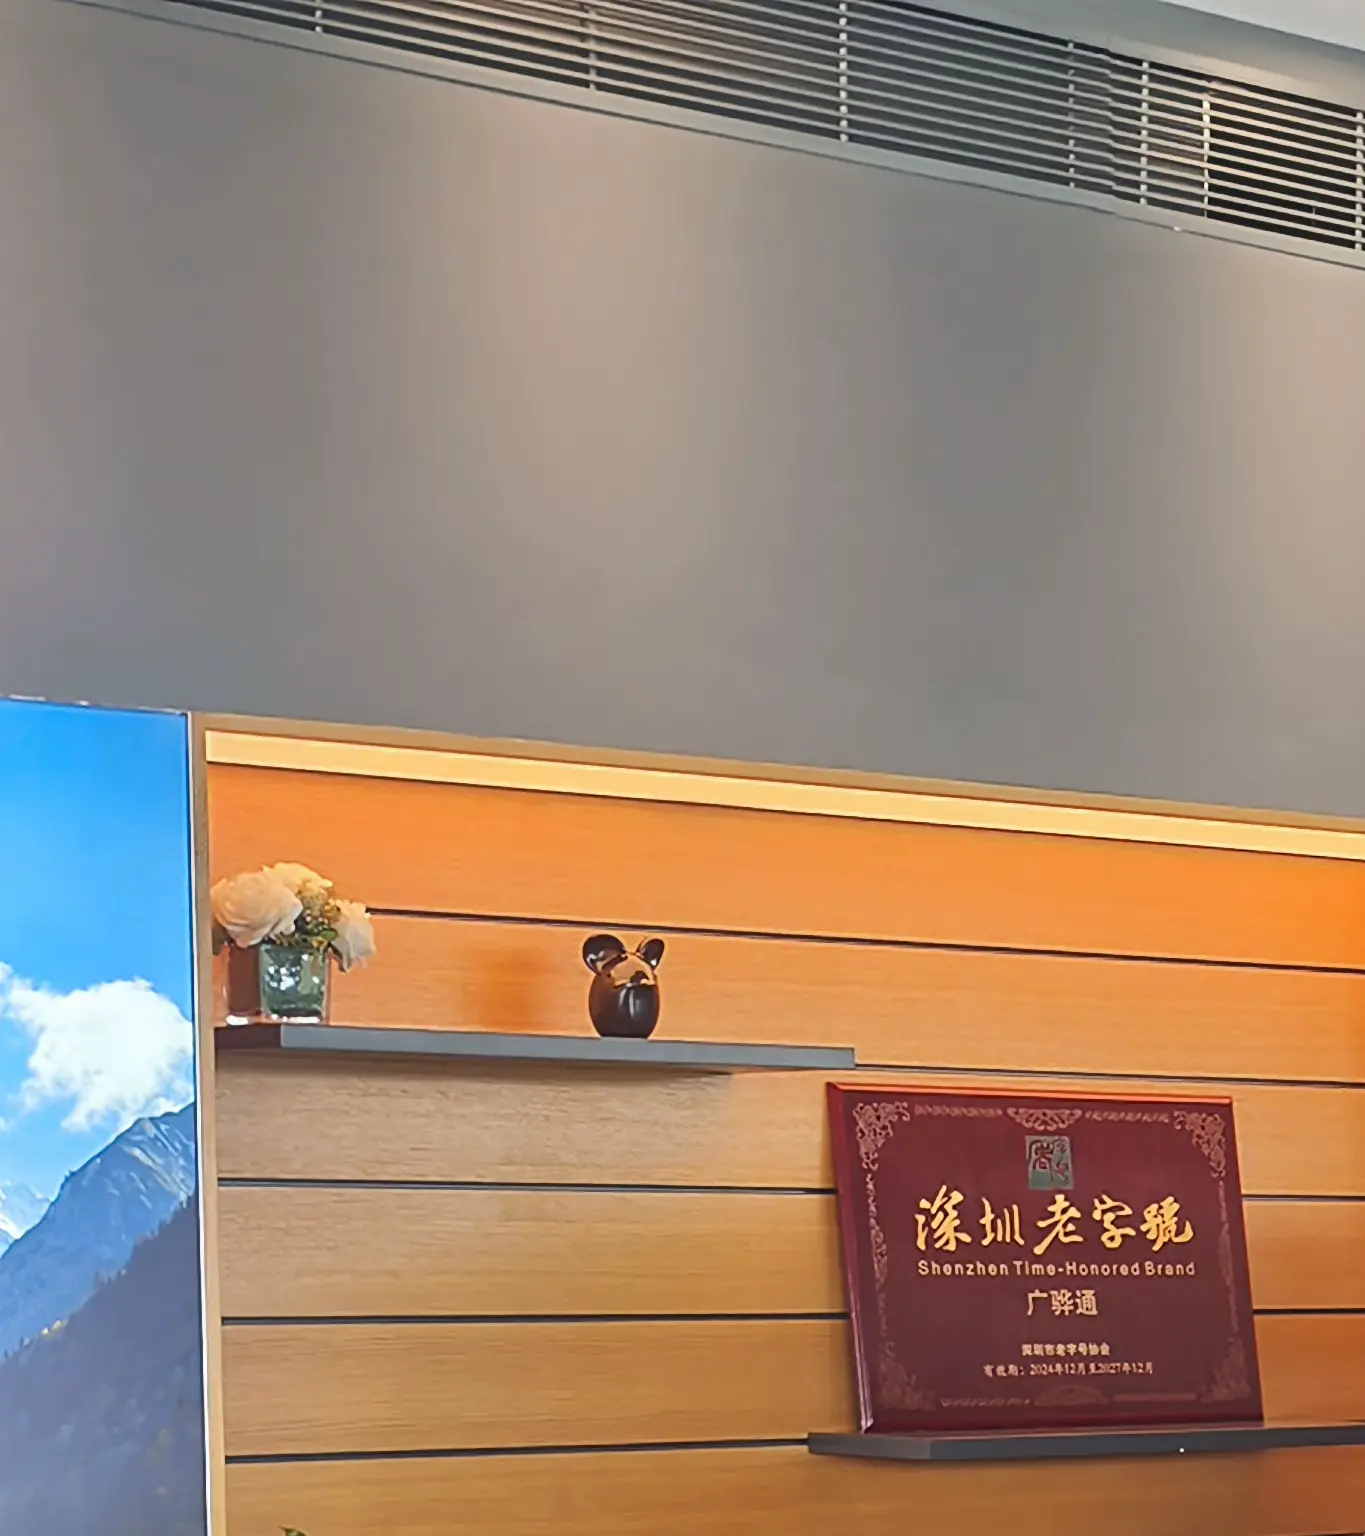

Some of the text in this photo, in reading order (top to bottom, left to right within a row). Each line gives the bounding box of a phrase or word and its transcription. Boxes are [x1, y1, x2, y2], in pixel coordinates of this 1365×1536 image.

[915, 1185, 1194, 1255] 深圳老字號
[918, 1260, 1195, 1276] Shenzhen Time-Honored Brand
[1027, 1289, 1098, 1316] 广骅通
